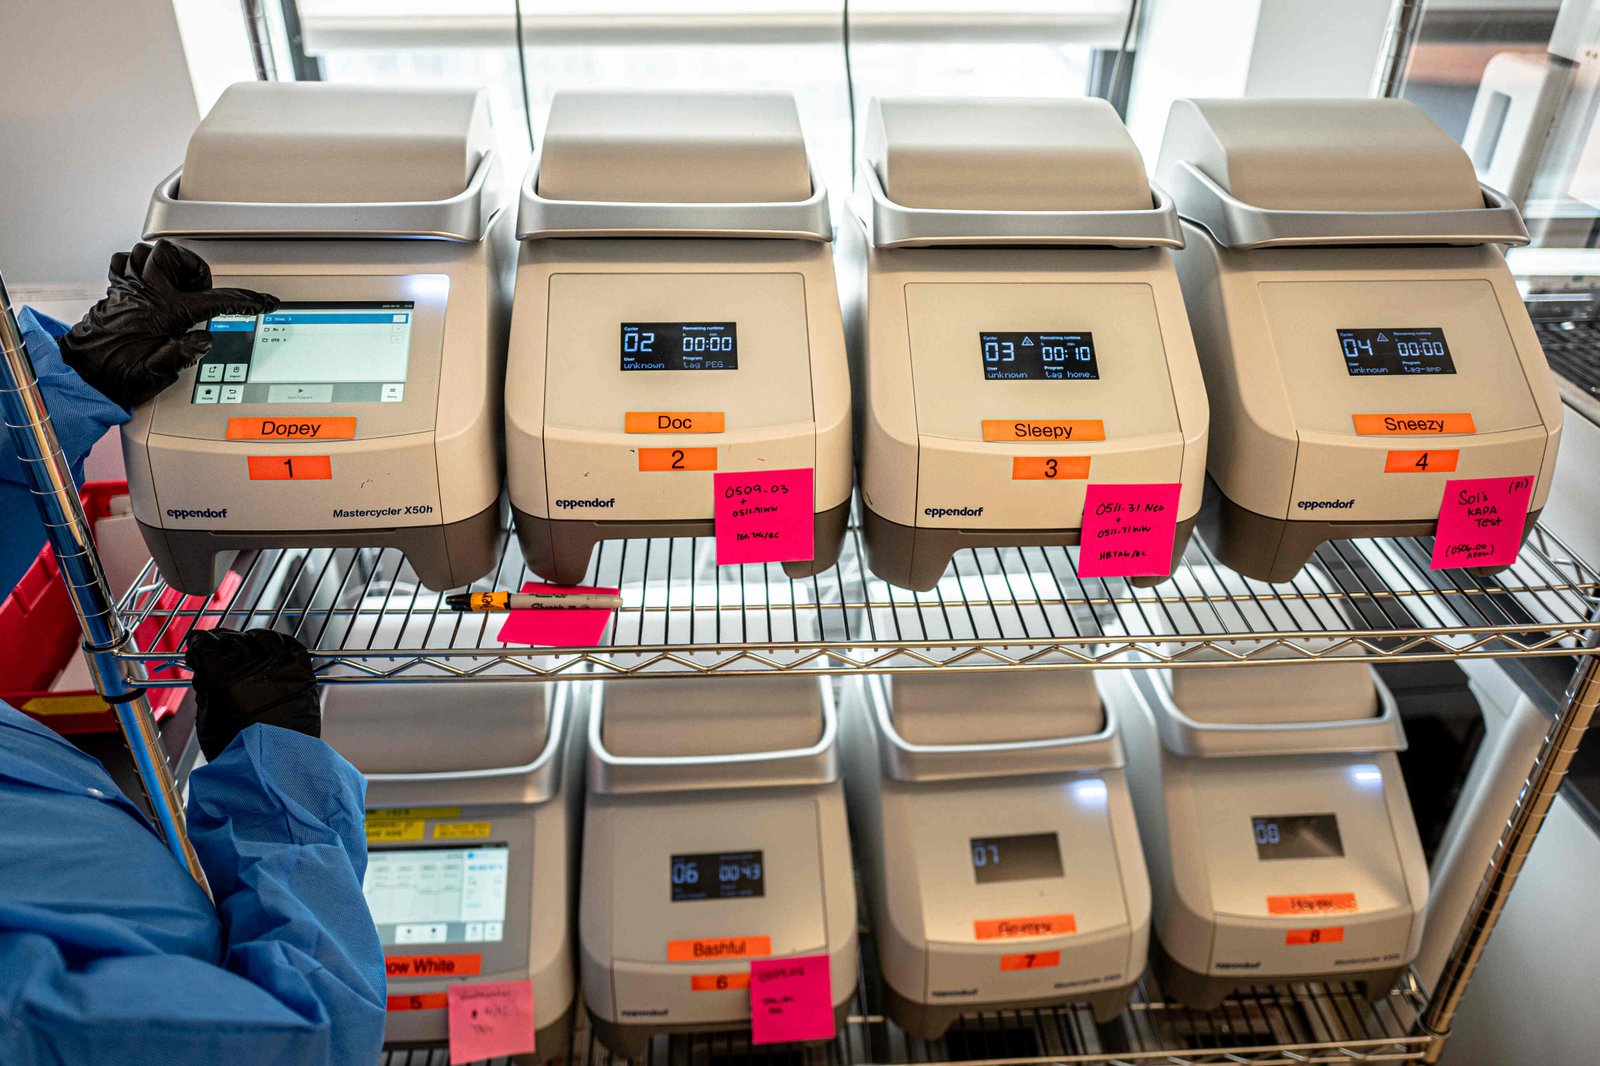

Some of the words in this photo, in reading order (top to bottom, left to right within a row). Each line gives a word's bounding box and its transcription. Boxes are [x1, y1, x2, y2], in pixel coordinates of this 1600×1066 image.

[624, 333, 654, 352] 02
[683, 337, 732, 351] 00:00
[1343, 339, 1373, 357] 04
[1398, 342, 1444, 356] 00:00
[985, 343, 1014, 361] 03
[1042, 347, 1090, 361] 00:10
[261, 421, 321, 437] Dopey
[658, 416, 692, 429] Doc
[1384, 418, 1444, 432] Sneezy
[1015, 423, 1072, 439] Sleepy
[672, 450, 684, 468] 2
[1415, 453, 1428, 470] 4
[284, 459, 293, 477] 1
[1045, 459, 1057, 478] 3
[556, 498, 615, 509] eppendorf
[1298, 500, 1355, 510] eppendorf
[167, 509, 227, 519] eppendorf
[333, 507, 401, 518] Mastercycler
[404, 505, 433, 515] X50h
[924, 507, 983, 517] eppendorf
[1474, 517, 1502, 527] Test
[973, 845, 999, 867] 07
[673, 863, 699, 884] 06
[1310, 930, 1320, 943] 8
[693, 942, 746, 956] Bashful
[413, 960, 455, 973] White
[1025, 955, 1036, 968] 7
[716, 976, 728, 990] 6
